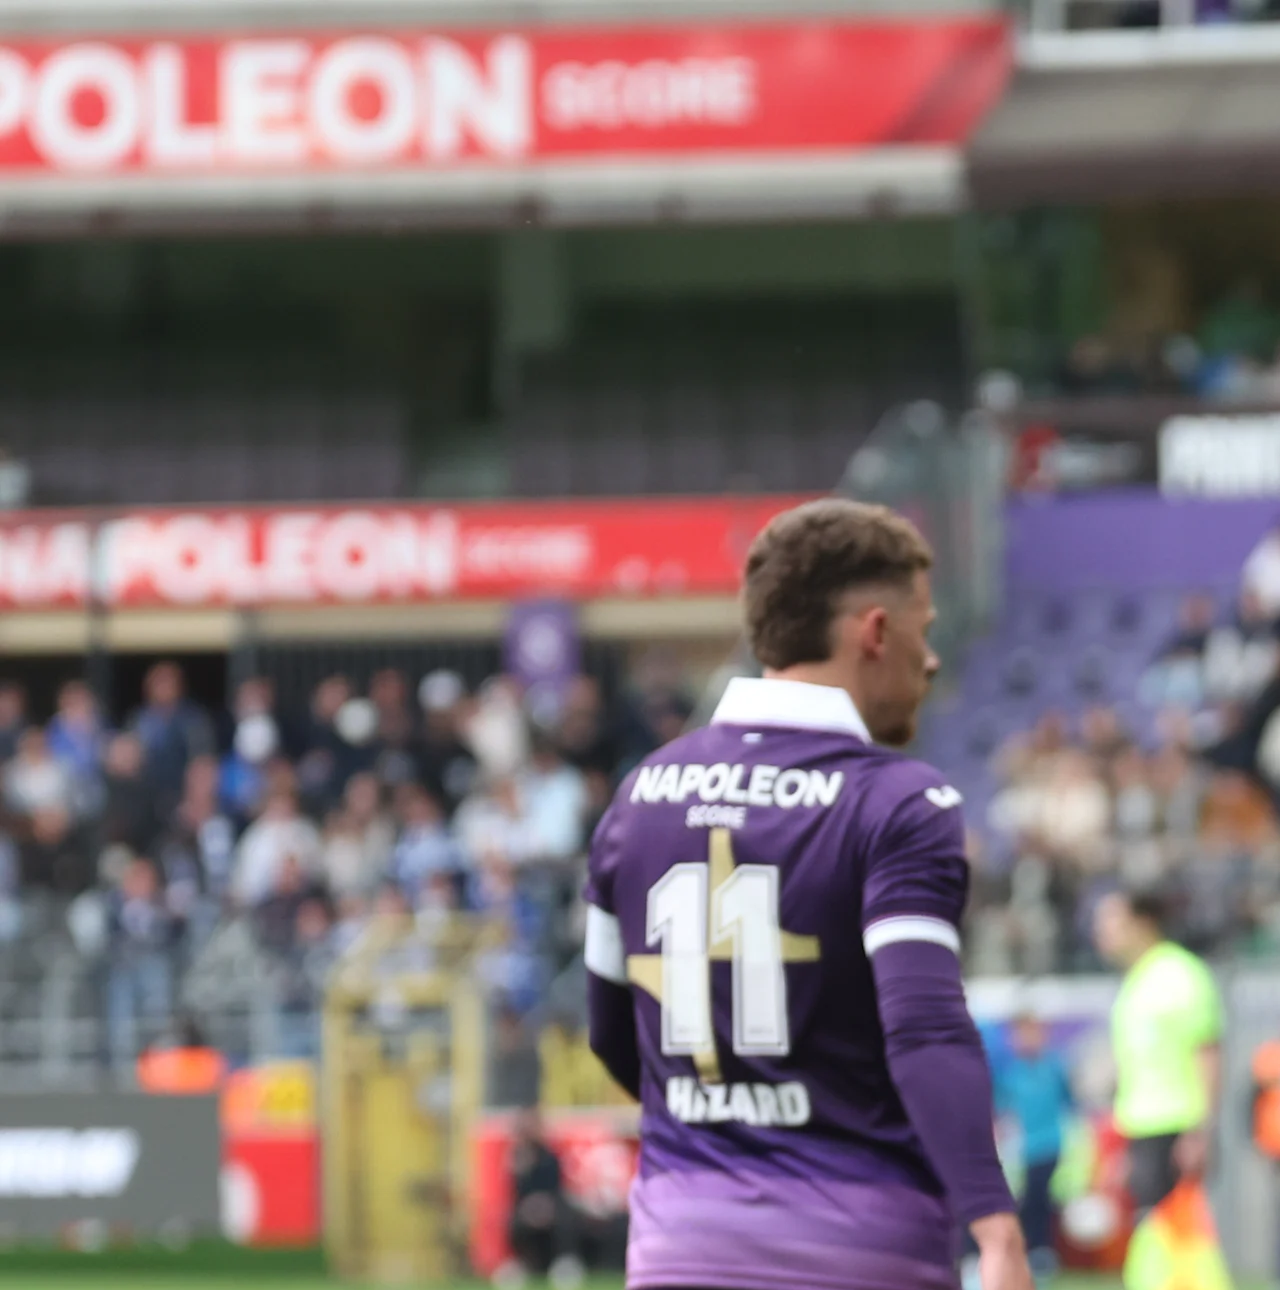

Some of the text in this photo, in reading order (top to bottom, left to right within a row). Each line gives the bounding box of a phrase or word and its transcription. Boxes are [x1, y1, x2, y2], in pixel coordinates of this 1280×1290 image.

[0, 40, 534, 170] OLEON
[630, 763, 844, 809] NAPOLEON
[685, 804, 747, 828] SCORE
[645, 861, 789, 1057] 11
